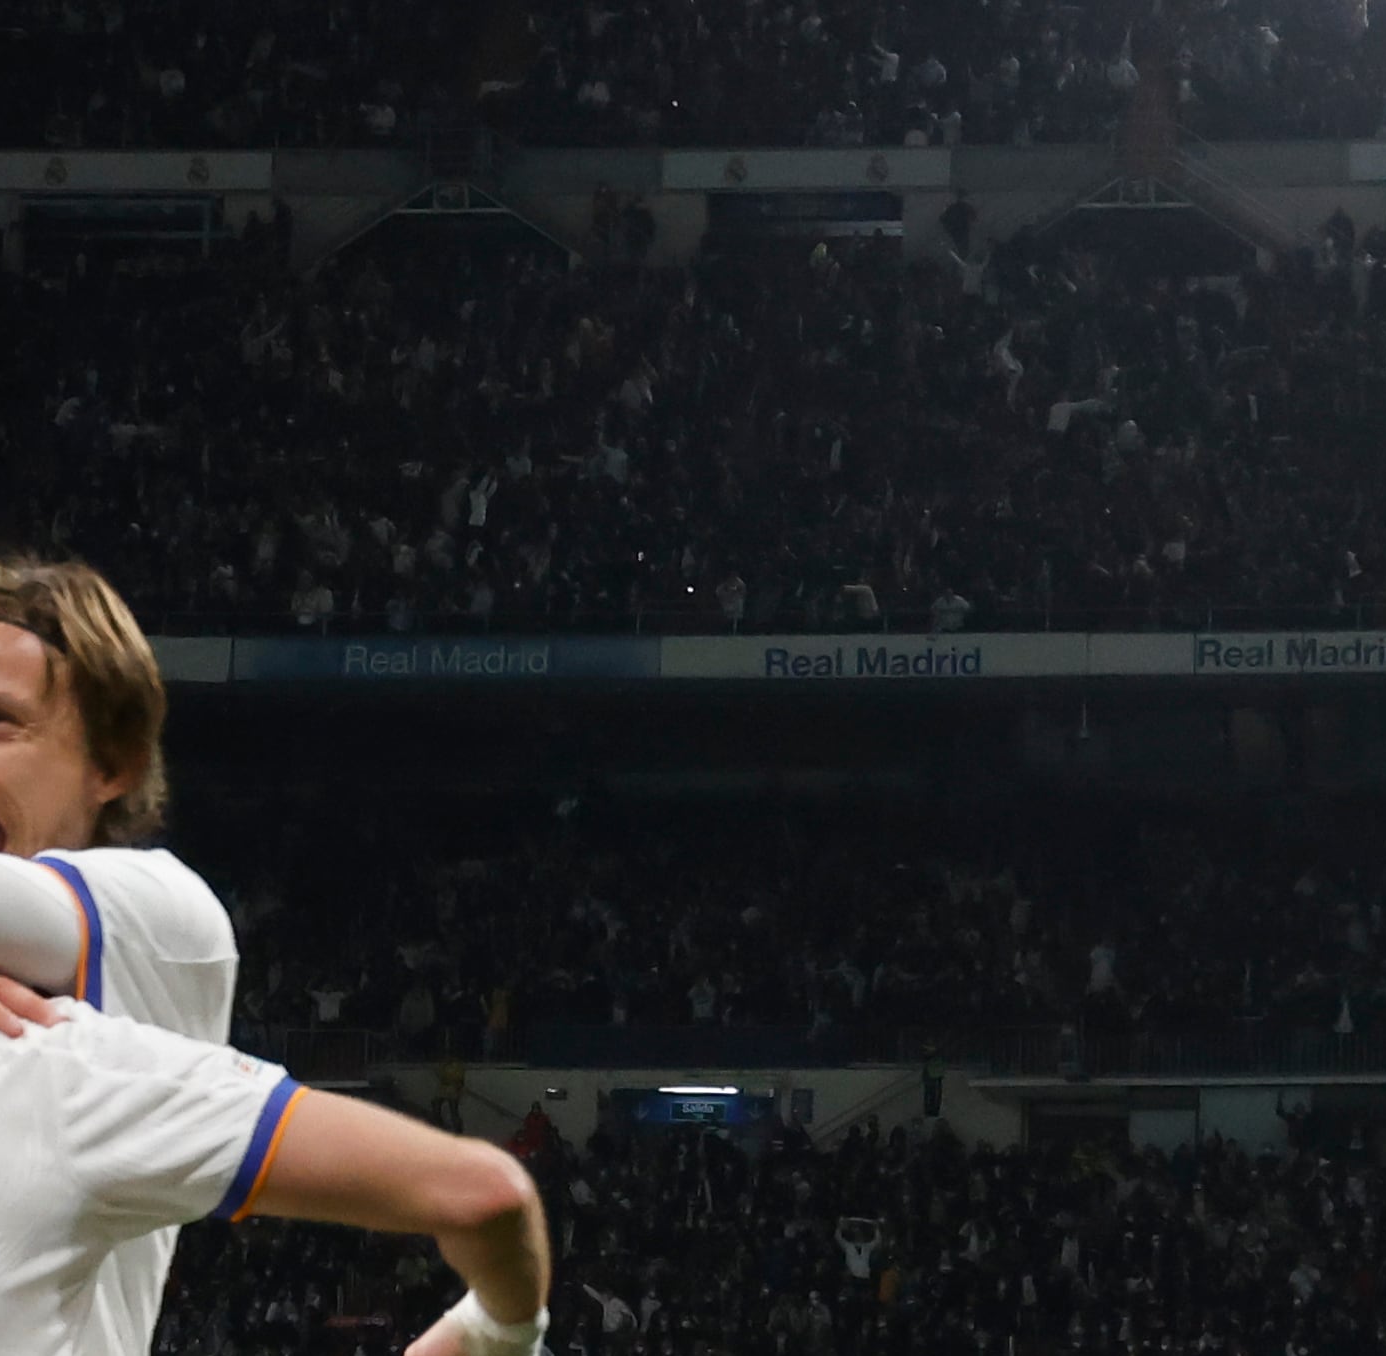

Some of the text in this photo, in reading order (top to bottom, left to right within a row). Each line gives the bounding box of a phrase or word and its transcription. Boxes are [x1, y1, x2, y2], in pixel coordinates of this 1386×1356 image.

[345, 645, 550, 674] Real Madrid
[765, 647, 982, 677] Real Madrid
[1197, 639, 1274, 668] Real
